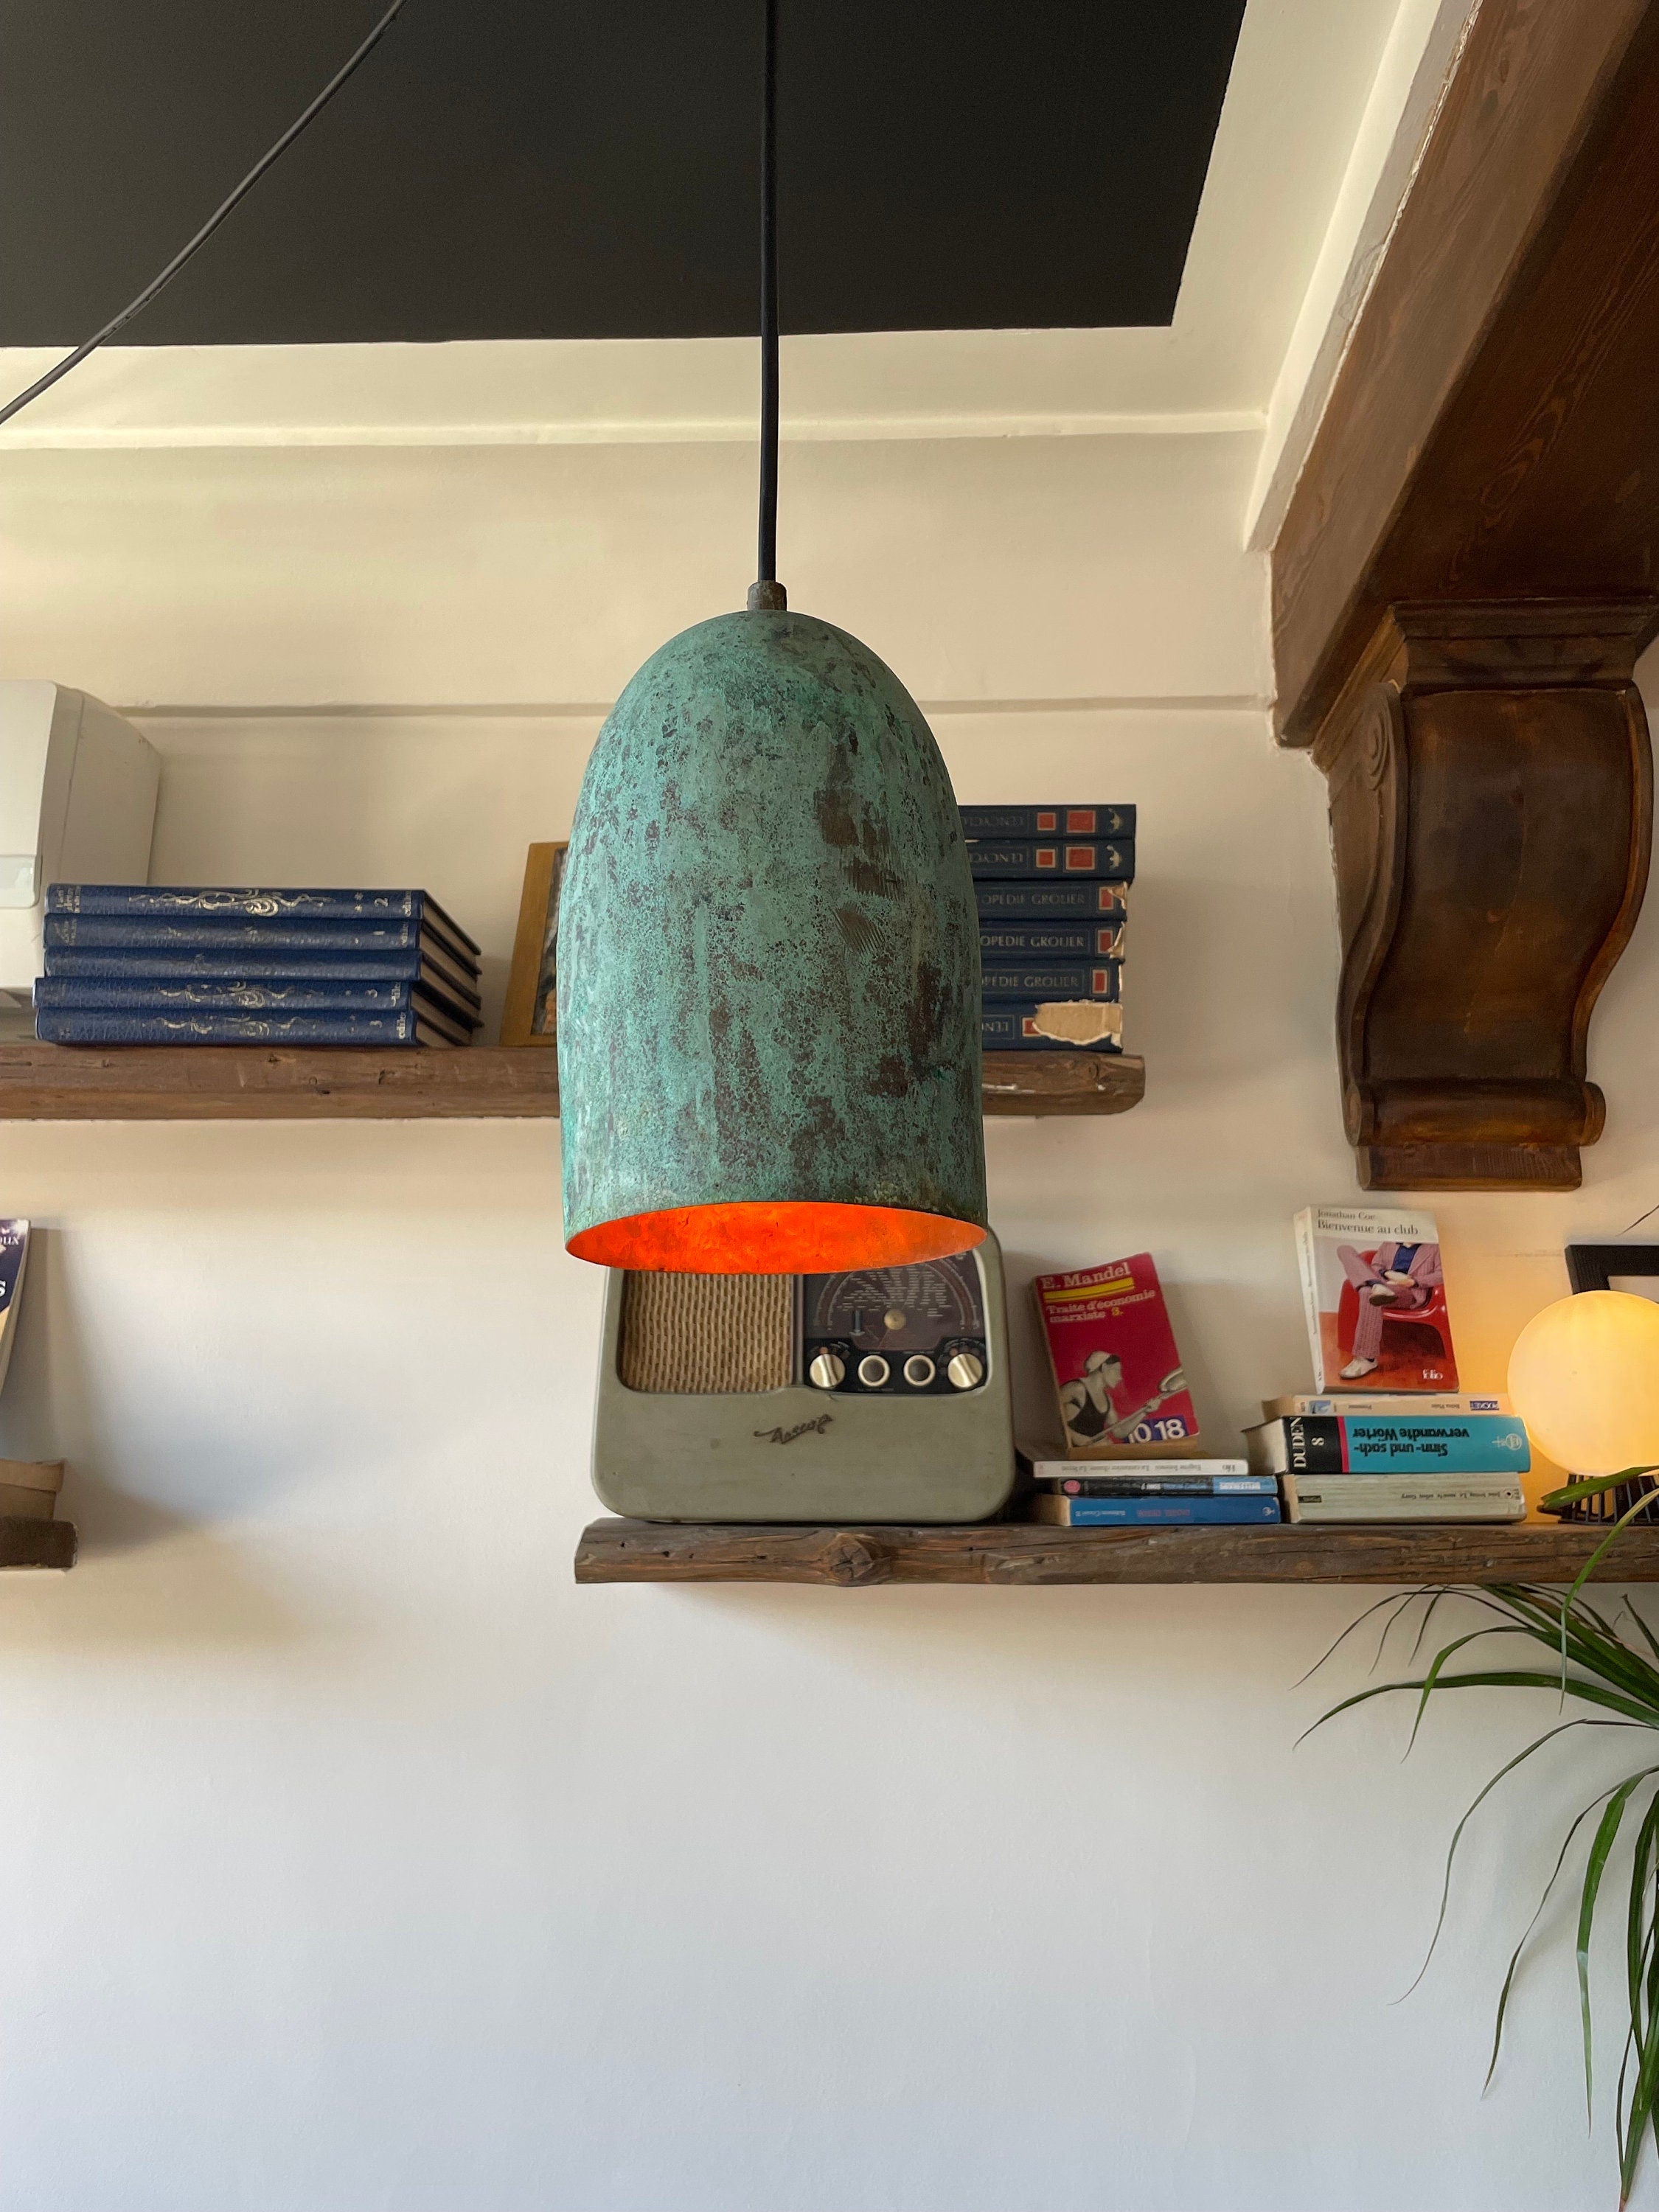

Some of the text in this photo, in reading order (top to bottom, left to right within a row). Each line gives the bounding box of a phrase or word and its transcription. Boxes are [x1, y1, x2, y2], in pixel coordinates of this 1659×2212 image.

[1032, 893, 1085, 905] GROLIER
[1030, 935, 1085, 947] GROLIER
[1024, 975, 1079, 987] GROLIER
[1318, 1209, 1356, 1220] Jonathan
[1318, 1219, 1419, 1235] Bienvenue au club
[1040, 1262, 1132, 1290] E. Mandel
[1049, 1310, 1106, 1323] marxiste
[1153, 1419, 1186, 1441] 18
[1352, 1427, 1470, 1441] verwandte Wörter
[1289, 1416, 1307, 1468] DUDEN
[1354, 1443, 1448, 1457] Sinn- und sach-
